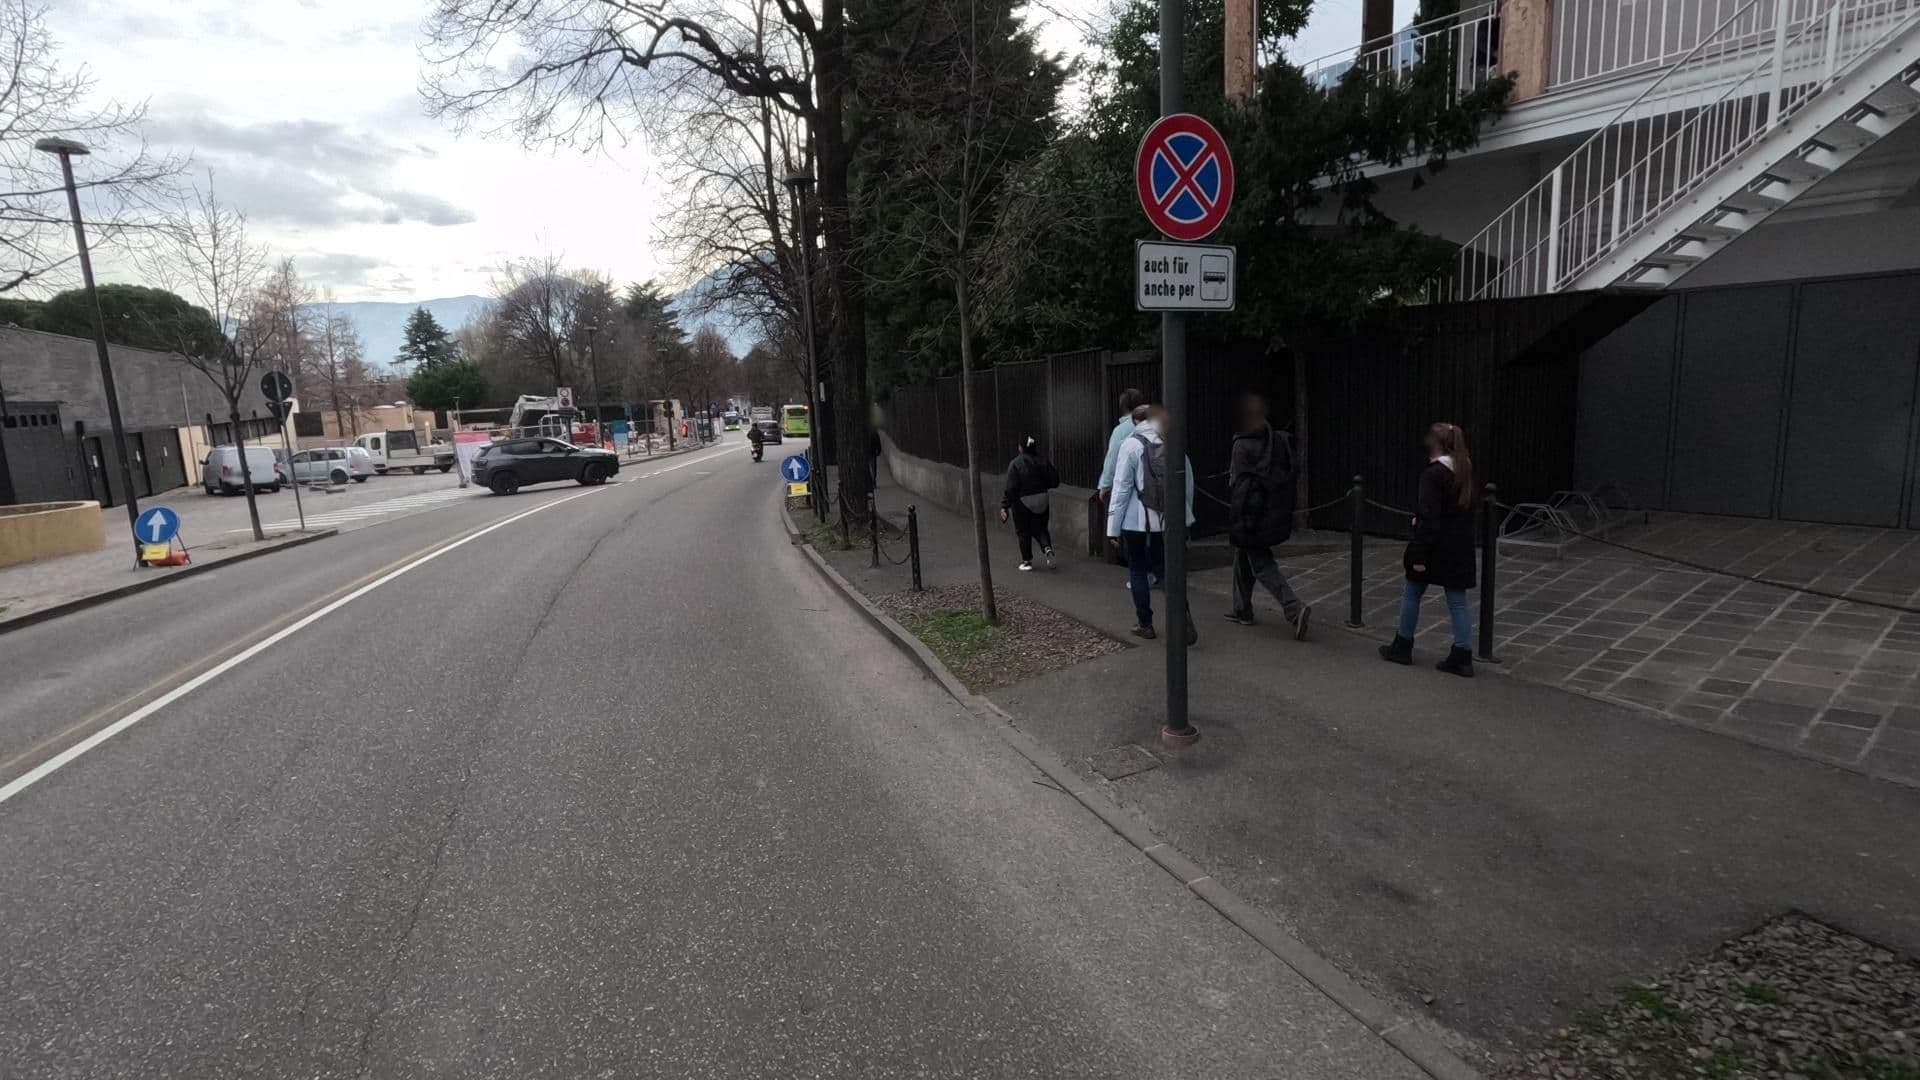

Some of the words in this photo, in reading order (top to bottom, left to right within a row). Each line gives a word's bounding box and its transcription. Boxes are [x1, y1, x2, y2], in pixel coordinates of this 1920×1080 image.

[1144, 256, 1169, 273] auch
[1173, 256, 1189, 274] für
[1144, 279, 1175, 296] anche
[1179, 284, 1195, 301] per
